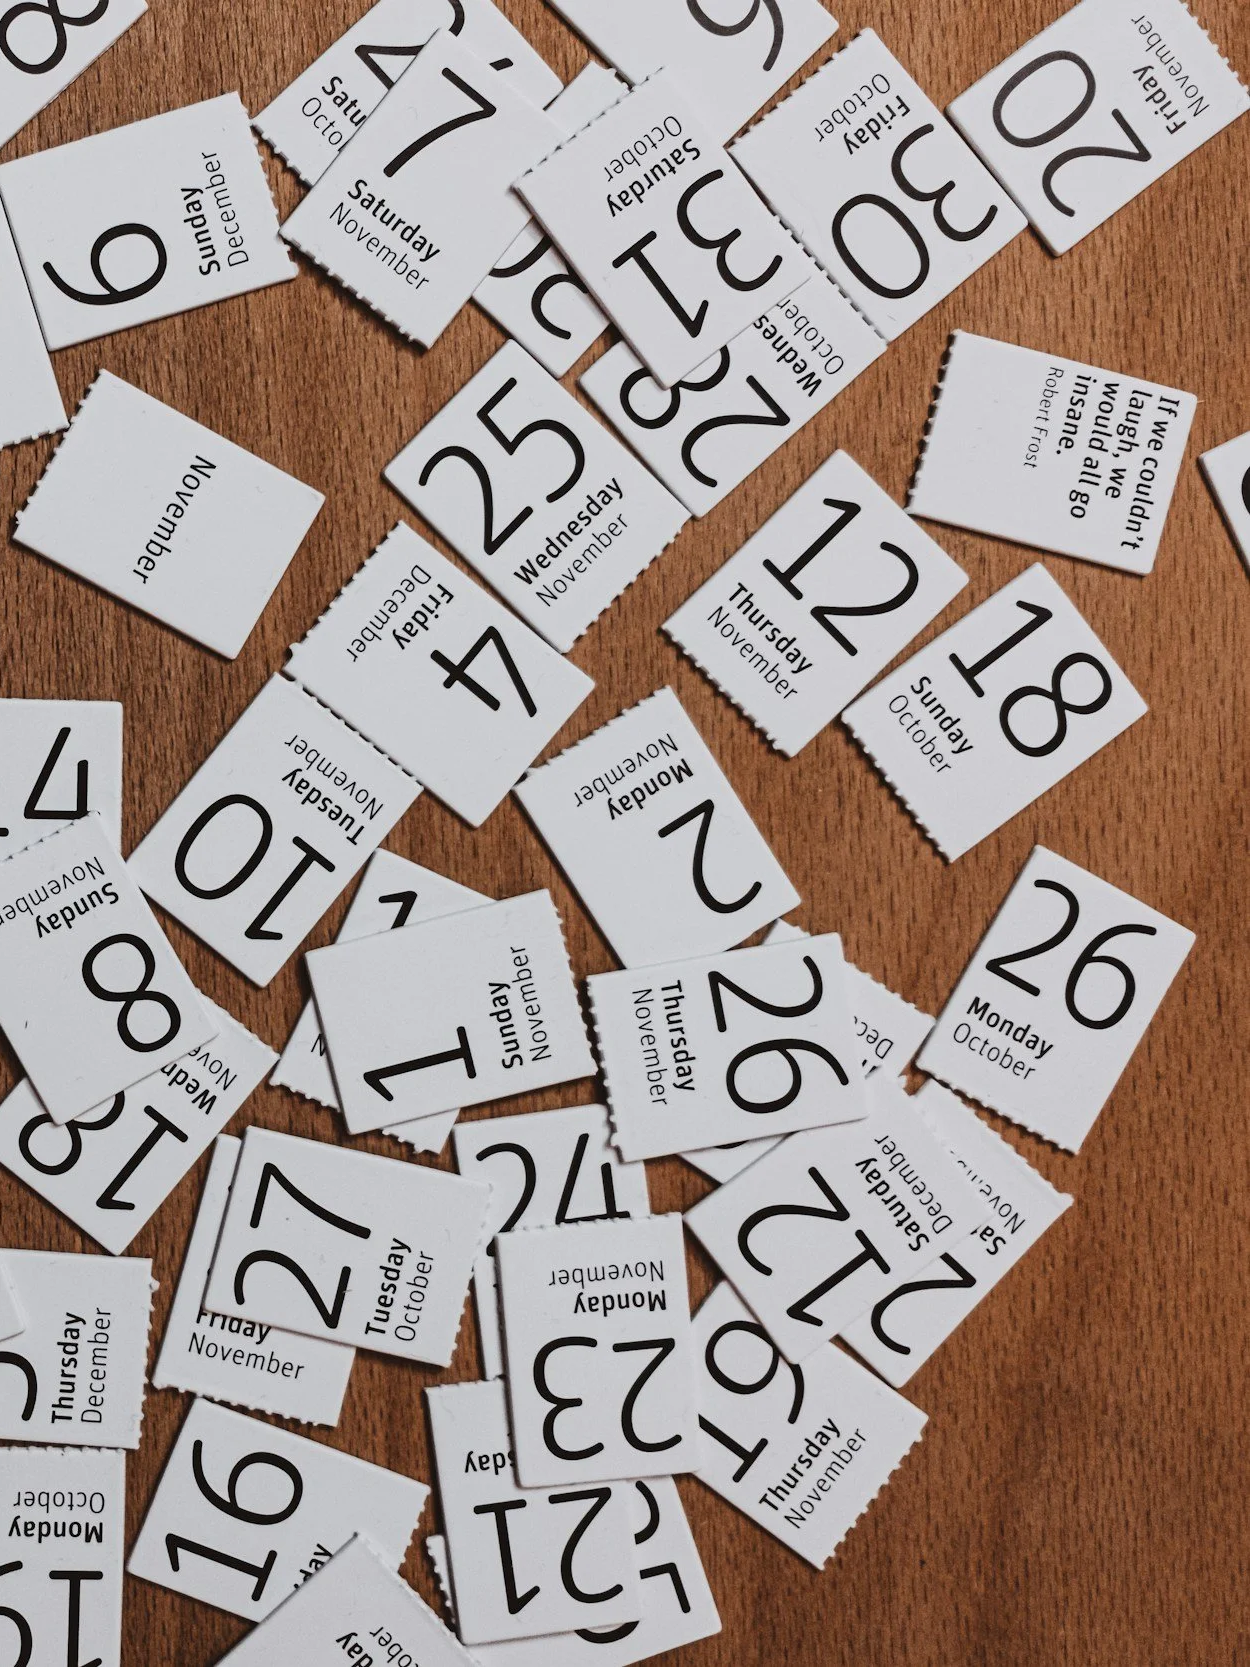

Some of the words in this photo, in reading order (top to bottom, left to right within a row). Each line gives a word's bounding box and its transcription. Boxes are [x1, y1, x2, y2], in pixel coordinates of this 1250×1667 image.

[322, 76, 367, 127] Satu
[815, 74, 890, 142] October
[1131, 16, 1209, 117] November
[1133, 66, 1186, 134] Friday
[383, 67, 496, 177] 7
[604, 116, 682, 182] October
[844, 95, 910, 155] Friday
[993, 51, 1152, 217] 20
[202, 153, 249, 267] December
[348, 179, 440, 262] Saturday
[607, 139, 700, 217] Saturday
[832, 124, 998, 299] 30
[43, 223, 167, 305] 6
[181, 188, 220, 275] Sunday
[330, 202, 429, 289] November
[612, 169, 783, 338] 31
[752, 315, 822, 397] Wednes
[1036, 367, 1064, 421] Robert
[1024, 427, 1048, 468] Frost
[1056, 375, 1097, 454] insane.
[1088, 383, 1119, 452] would
[1113, 390, 1154, 459] laugh,
[1148, 422, 1168, 451] we
[1158, 396, 1180, 417] If
[419, 377, 585, 555] 25
[1069, 490, 1090, 518] go
[1079, 457, 1102, 486] all
[1105, 469, 1126, 498] we
[133, 455, 216, 584] November
[514, 478, 623, 585] Wednesday
[536, 514, 627, 607] November
[347, 565, 431, 662] December
[393, 584, 454, 650] Friday
[763, 498, 919, 656] 12
[430, 626, 537, 717] 4
[707, 606, 797, 699] November
[729, 582, 813, 674] Thursday
[911, 676, 973, 754] Sunday
[949, 600, 1112, 757] 18
[284, 735, 383, 820] November
[574, 733, 678, 807] November
[889, 695, 951, 772] October
[282, 768, 364, 845] Tuesday
[607, 758, 693, 820] Monday
[175, 794, 335, 940] 10
[658, 799, 762, 914] 2
[36, 883, 119, 938] Sunday
[985, 879, 1157, 1030] 26
[82, 933, 181, 1053] 8
[488, 983, 523, 1069] Sunday
[510, 947, 552, 1061] November
[661, 980, 696, 1090] Thursday
[708, 956, 849, 1114] 26
[967, 996, 1053, 1059] Monday
[363, 1026, 476, 1101] 1
[632, 989, 667, 1104] November
[954, 1023, 1035, 1079] October
[18, 1091, 188, 1210] 18
[874, 1136, 953, 1234] December
[234, 1162, 371, 1329] 27
[738, 1167, 920, 1327] 12
[855, 1158, 929, 1251] Saturday
[365, 1238, 411, 1335] Tuesday
[395, 1251, 433, 1341] October
[549, 1261, 664, 1289] November
[574, 1290, 666, 1317] Monday
[51, 1312, 86, 1424] Thursday
[81, 1307, 111, 1423] December
[188, 1332, 304, 1379] November
[533, 1336, 682, 1461] 23
[13, 1491, 105, 1514] October
[758, 1418, 840, 1510] Thursday
[784, 1428, 866, 1529] November
[8, 1515, 103, 1543] Monday
[165, 1440, 303, 1601] 16
[473, 1486, 623, 1615] 21
